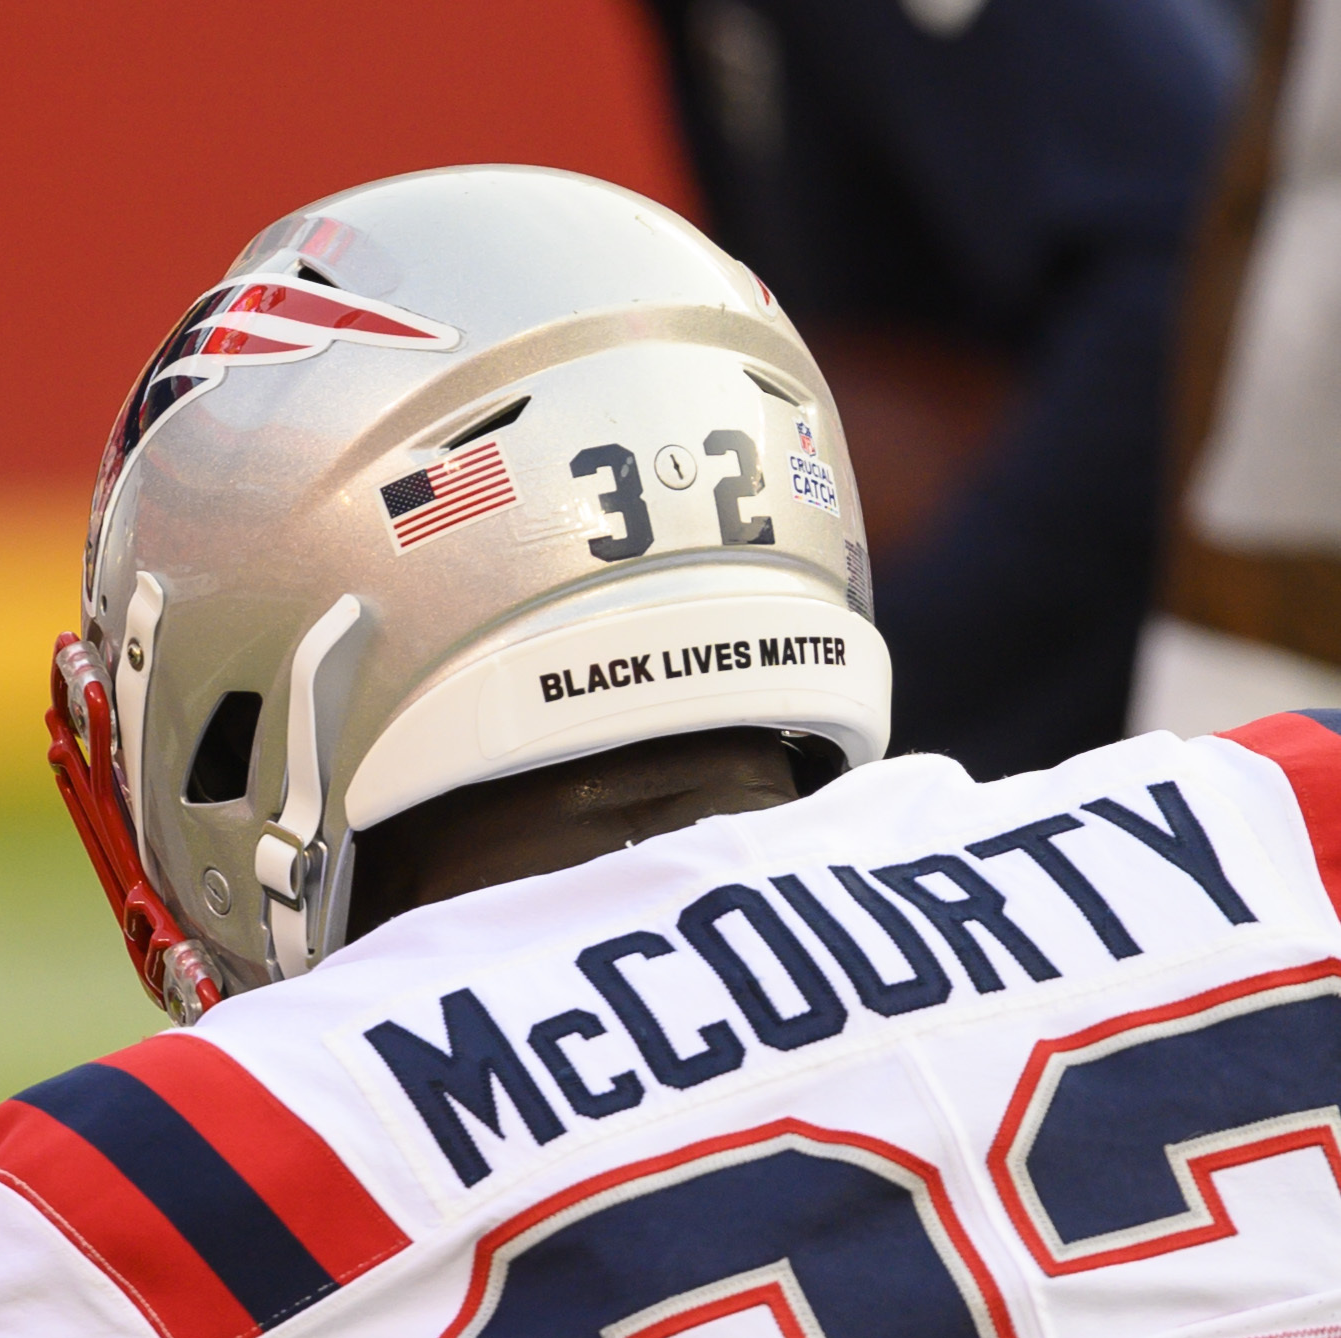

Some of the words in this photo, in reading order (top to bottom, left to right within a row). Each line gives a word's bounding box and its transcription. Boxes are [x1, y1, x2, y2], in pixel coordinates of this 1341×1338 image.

[790, 456, 833, 485] CRUCIAL
[793, 474, 837, 508] CATCH
[539, 654, 654, 703] BLACK
[662, 641, 752, 680] LIVES
[759, 637, 846, 666] MATTER
[363, 780, 1260, 1188] McCOURTY
